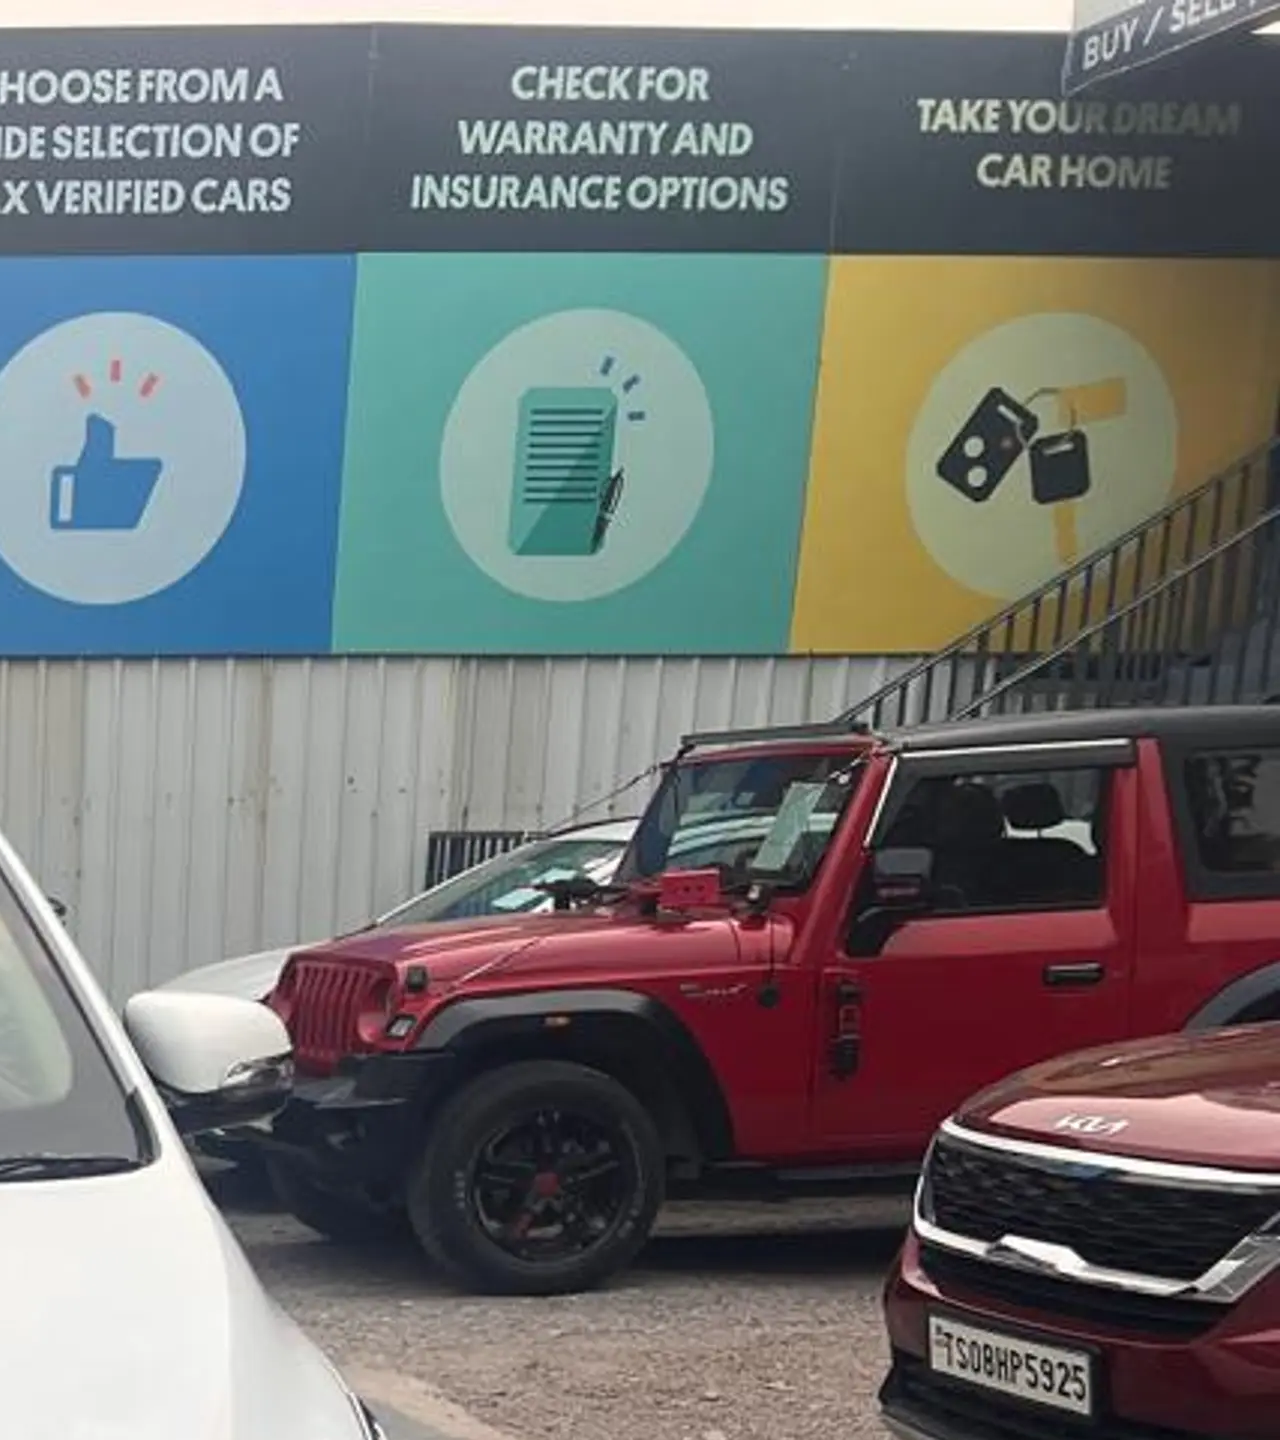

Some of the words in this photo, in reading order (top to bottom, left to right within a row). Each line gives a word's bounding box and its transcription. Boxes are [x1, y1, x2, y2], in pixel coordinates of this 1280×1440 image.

[1082, 16, 1139, 71] BUY
[137, 67, 248, 102] FROM
[252, 67, 284, 102] A
[511, 66, 634, 100] CHECK
[637, 66, 709, 100] FOR
[916, 98, 1000, 133] TAKE
[1006, 98, 1107, 134] YOUR
[1112, 101, 1239, 136] DREAM
[52, 123, 244, 160] SELECTION
[248, 122, 300, 157] OF
[457, 120, 670, 155] WARRANTY
[671, 121, 753, 156] AND
[976, 152, 1052, 188] CAR
[1059, 153, 1173, 190] HOME
[34, 179, 186, 214] VERIFIED
[190, 177, 292, 214] CARS
[410, 174, 622, 209] INSURANCE
[626, 175, 789, 211] OPTIONS
[944, 1331, 1087, 1401] TS08HP5925
